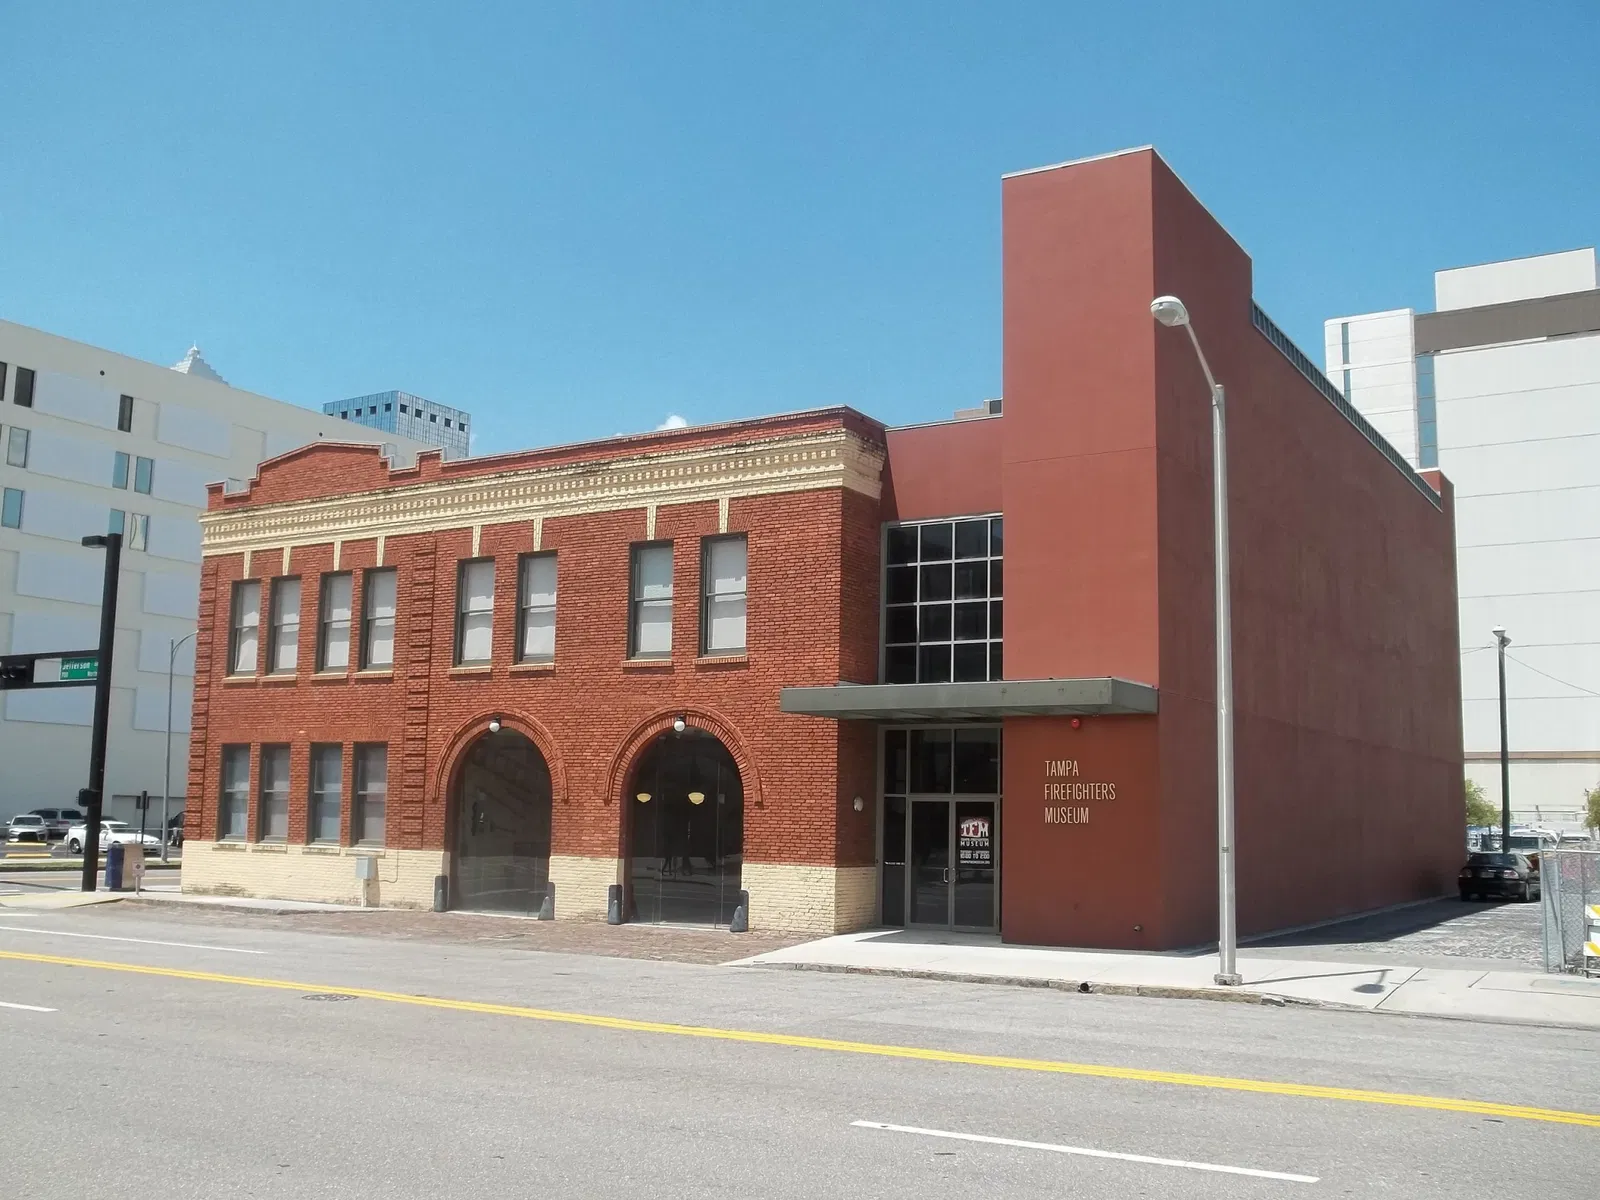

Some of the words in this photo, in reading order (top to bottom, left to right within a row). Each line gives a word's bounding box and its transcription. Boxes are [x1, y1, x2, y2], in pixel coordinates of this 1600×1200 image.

[1045, 760, 1079, 777] TAMPA
[1044, 783, 1116, 800] FIREFIGHTERS
[1044, 807, 1089, 824] MUSEUM
